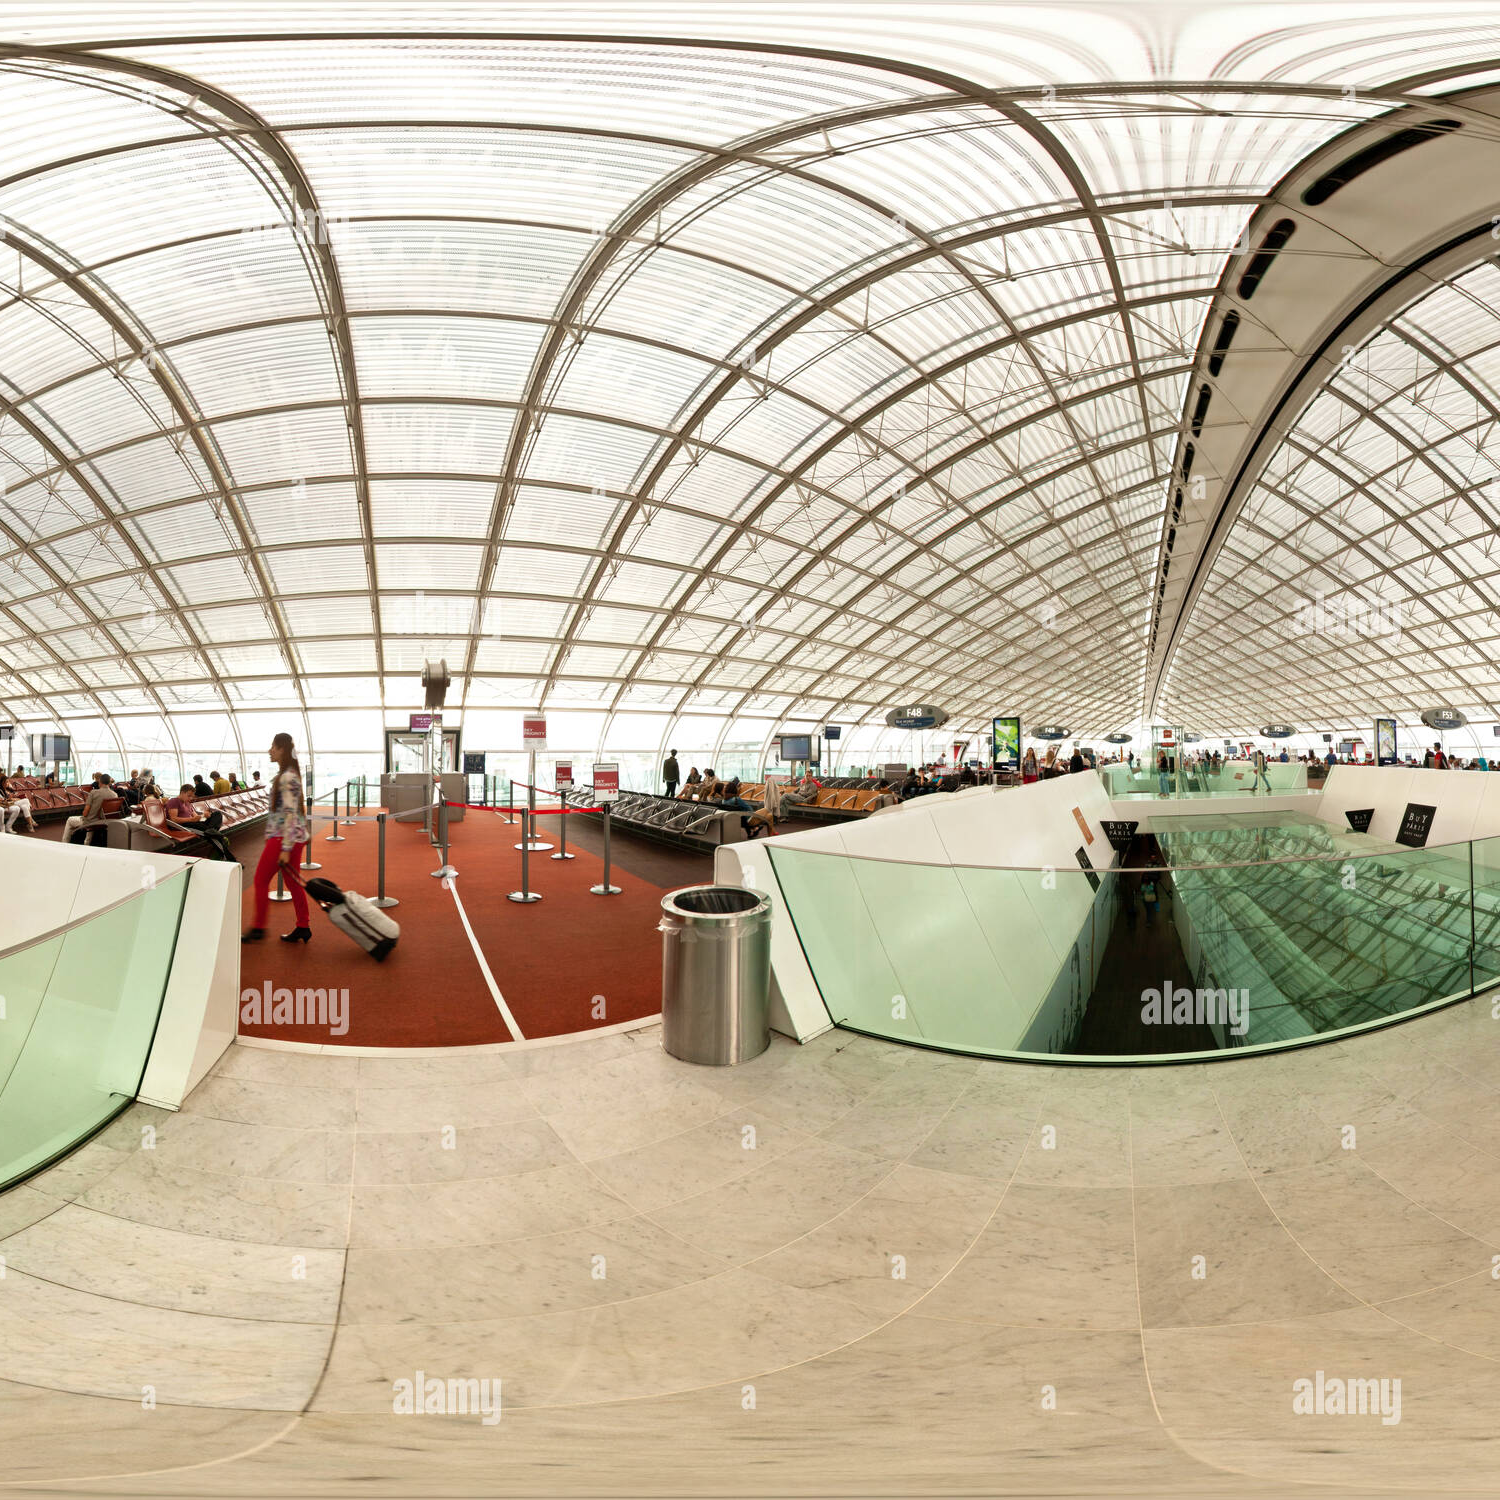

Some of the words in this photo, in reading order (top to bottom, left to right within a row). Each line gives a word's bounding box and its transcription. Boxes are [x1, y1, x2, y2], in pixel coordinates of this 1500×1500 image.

[906, 708, 922, 717] F48
[1442, 711, 1453, 719] F53
[1406, 822, 1425, 832] PARIS
